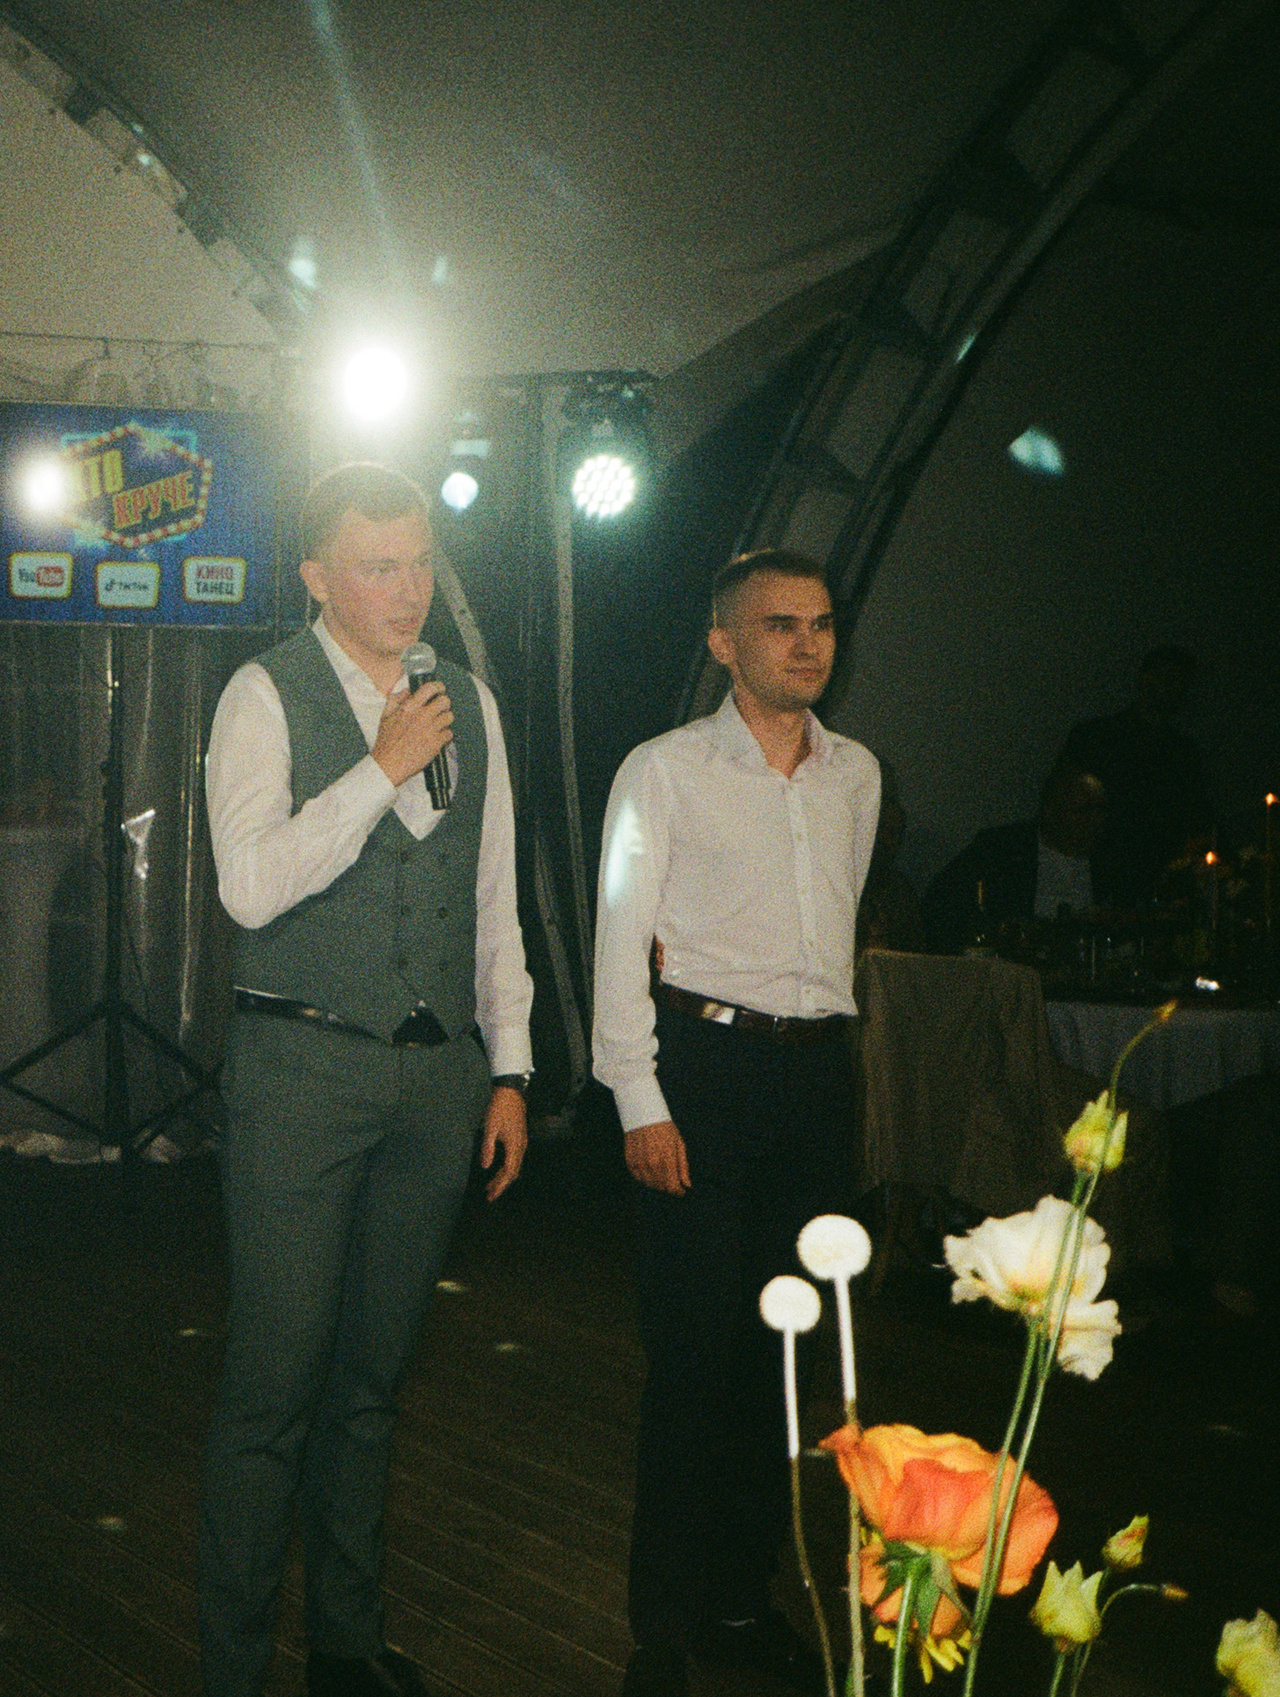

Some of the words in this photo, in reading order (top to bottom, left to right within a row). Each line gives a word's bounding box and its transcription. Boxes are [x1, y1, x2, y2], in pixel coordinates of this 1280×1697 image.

[112, 471, 195, 529] КРУЧЕ
[18, 567, 65, 587] YouTube
[196, 565, 234, 580] КИНО
[195, 581, 236, 596] ТАНЕЦ
